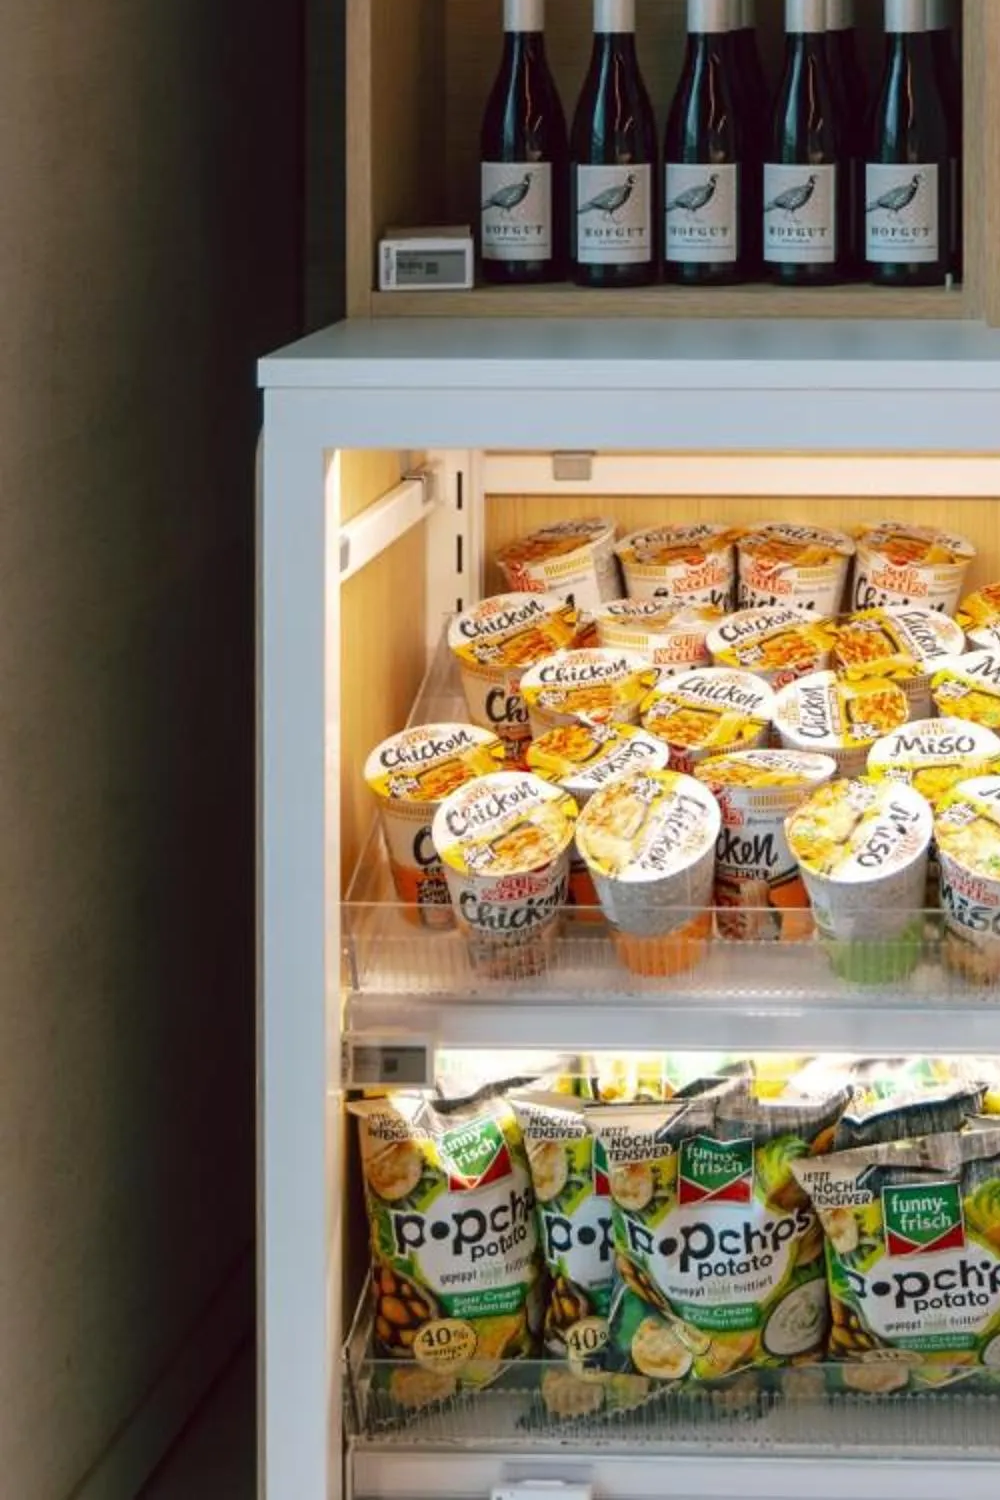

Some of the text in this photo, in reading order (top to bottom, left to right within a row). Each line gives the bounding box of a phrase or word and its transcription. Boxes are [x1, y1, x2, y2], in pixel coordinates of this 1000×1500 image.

[459, 599, 545, 639] Chicken
[719, 610, 801, 643] Chicken
[539, 658, 630, 684] Chicken
[677, 675, 765, 711] Chicken
[380, 730, 473, 769] Chicken
[890, 733, 977, 758] Miso
[446, 781, 540, 837] Chicken
[641, 794, 708, 871] Chicken
[857, 800, 920, 869] Miso
[715, 828, 778, 867] cken
[459, 878, 567, 932] Chicken
[527, 1127, 582, 1140] TENSIVER
[611, 1134, 652, 1149] NOCH
[608, 1145, 671, 1162] TENSIVER
[687, 1144, 740, 1165] funny-
[691, 1155, 744, 1178] frisch
[803, 1172, 831, 1184] JETZT
[811, 1191, 872, 1208] TENSIVER
[813, 1180, 854, 1195] NOCH
[891, 1193, 949, 1214] funny-
[899, 1212, 952, 1233] frisch
[471, 1226, 527, 1262] potato
[697, 1255, 774, 1281] potato
[914, 1291, 990, 1315] potato
